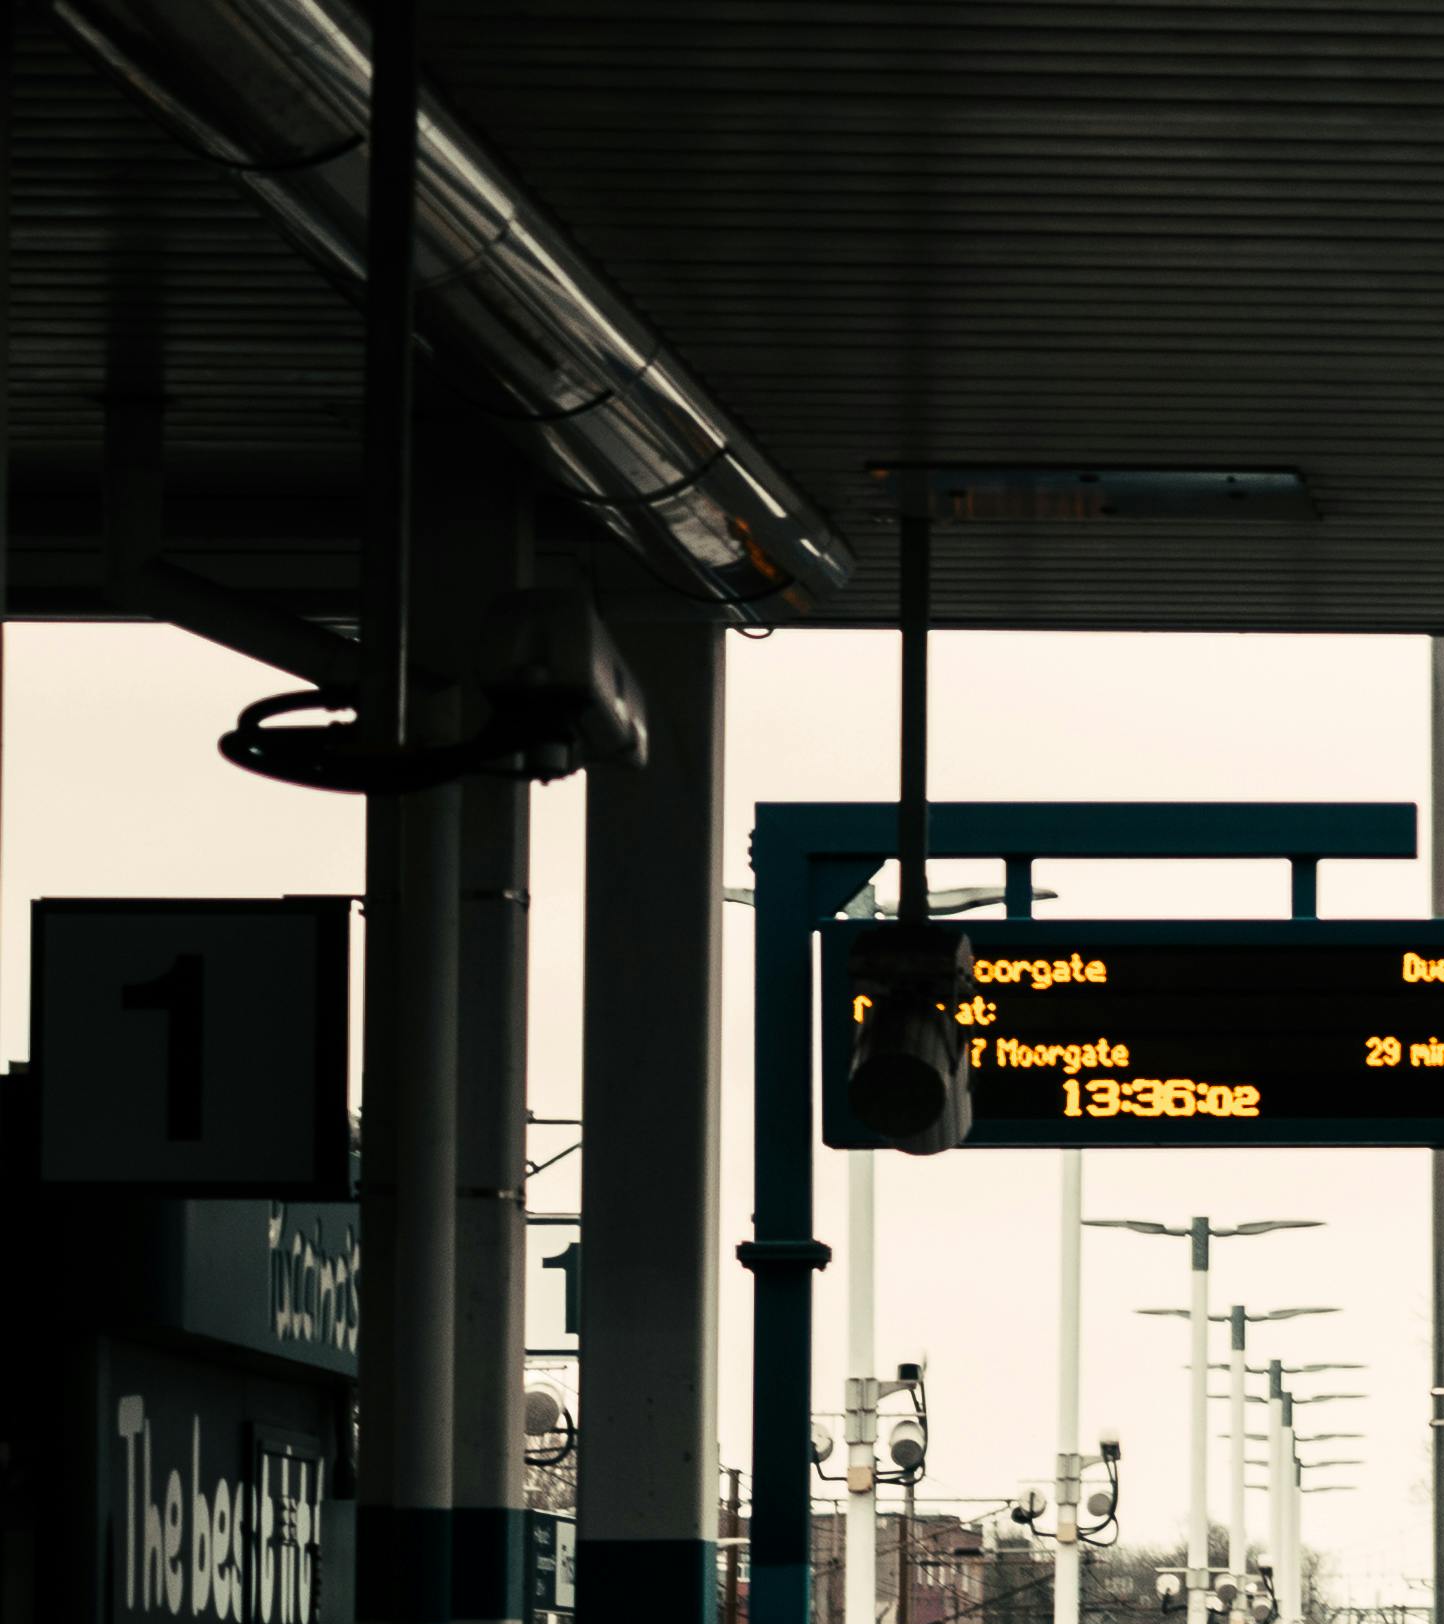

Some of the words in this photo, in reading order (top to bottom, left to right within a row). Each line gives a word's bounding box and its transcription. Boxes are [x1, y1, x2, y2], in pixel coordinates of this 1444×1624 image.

[974, 952, 1109, 990] oorgate
[123, 955, 203, 1141] 1
[996, 1036, 1131, 1075] Moorgate
[1364, 1034, 1402, 1068] 29
[1062, 1080, 1260, 1117] 13:36:02
[118, 1394, 184, 1616] The
